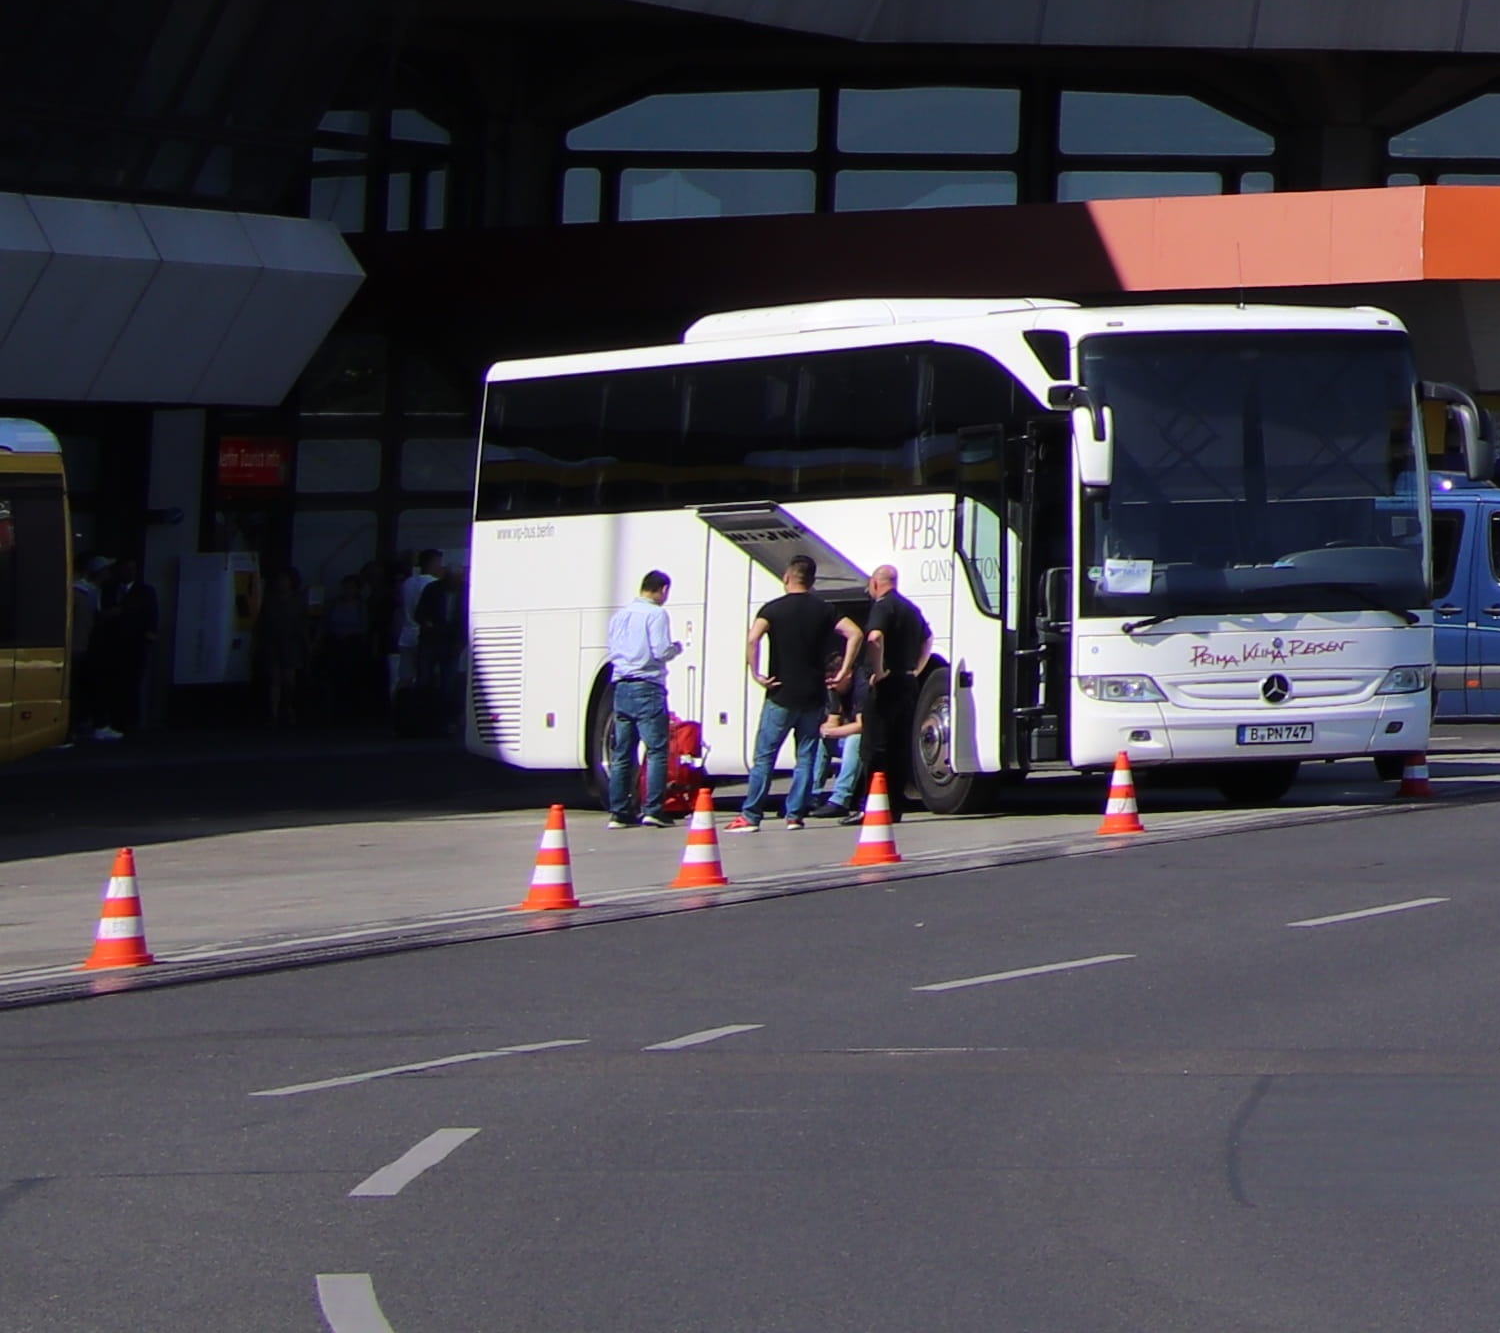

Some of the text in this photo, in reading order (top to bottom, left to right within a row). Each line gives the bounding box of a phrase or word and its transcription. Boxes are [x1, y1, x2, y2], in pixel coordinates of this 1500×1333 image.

[217, 446, 239, 468] erlin
[1189, 638, 1357, 670] PRIMA KLIMA REISEN
